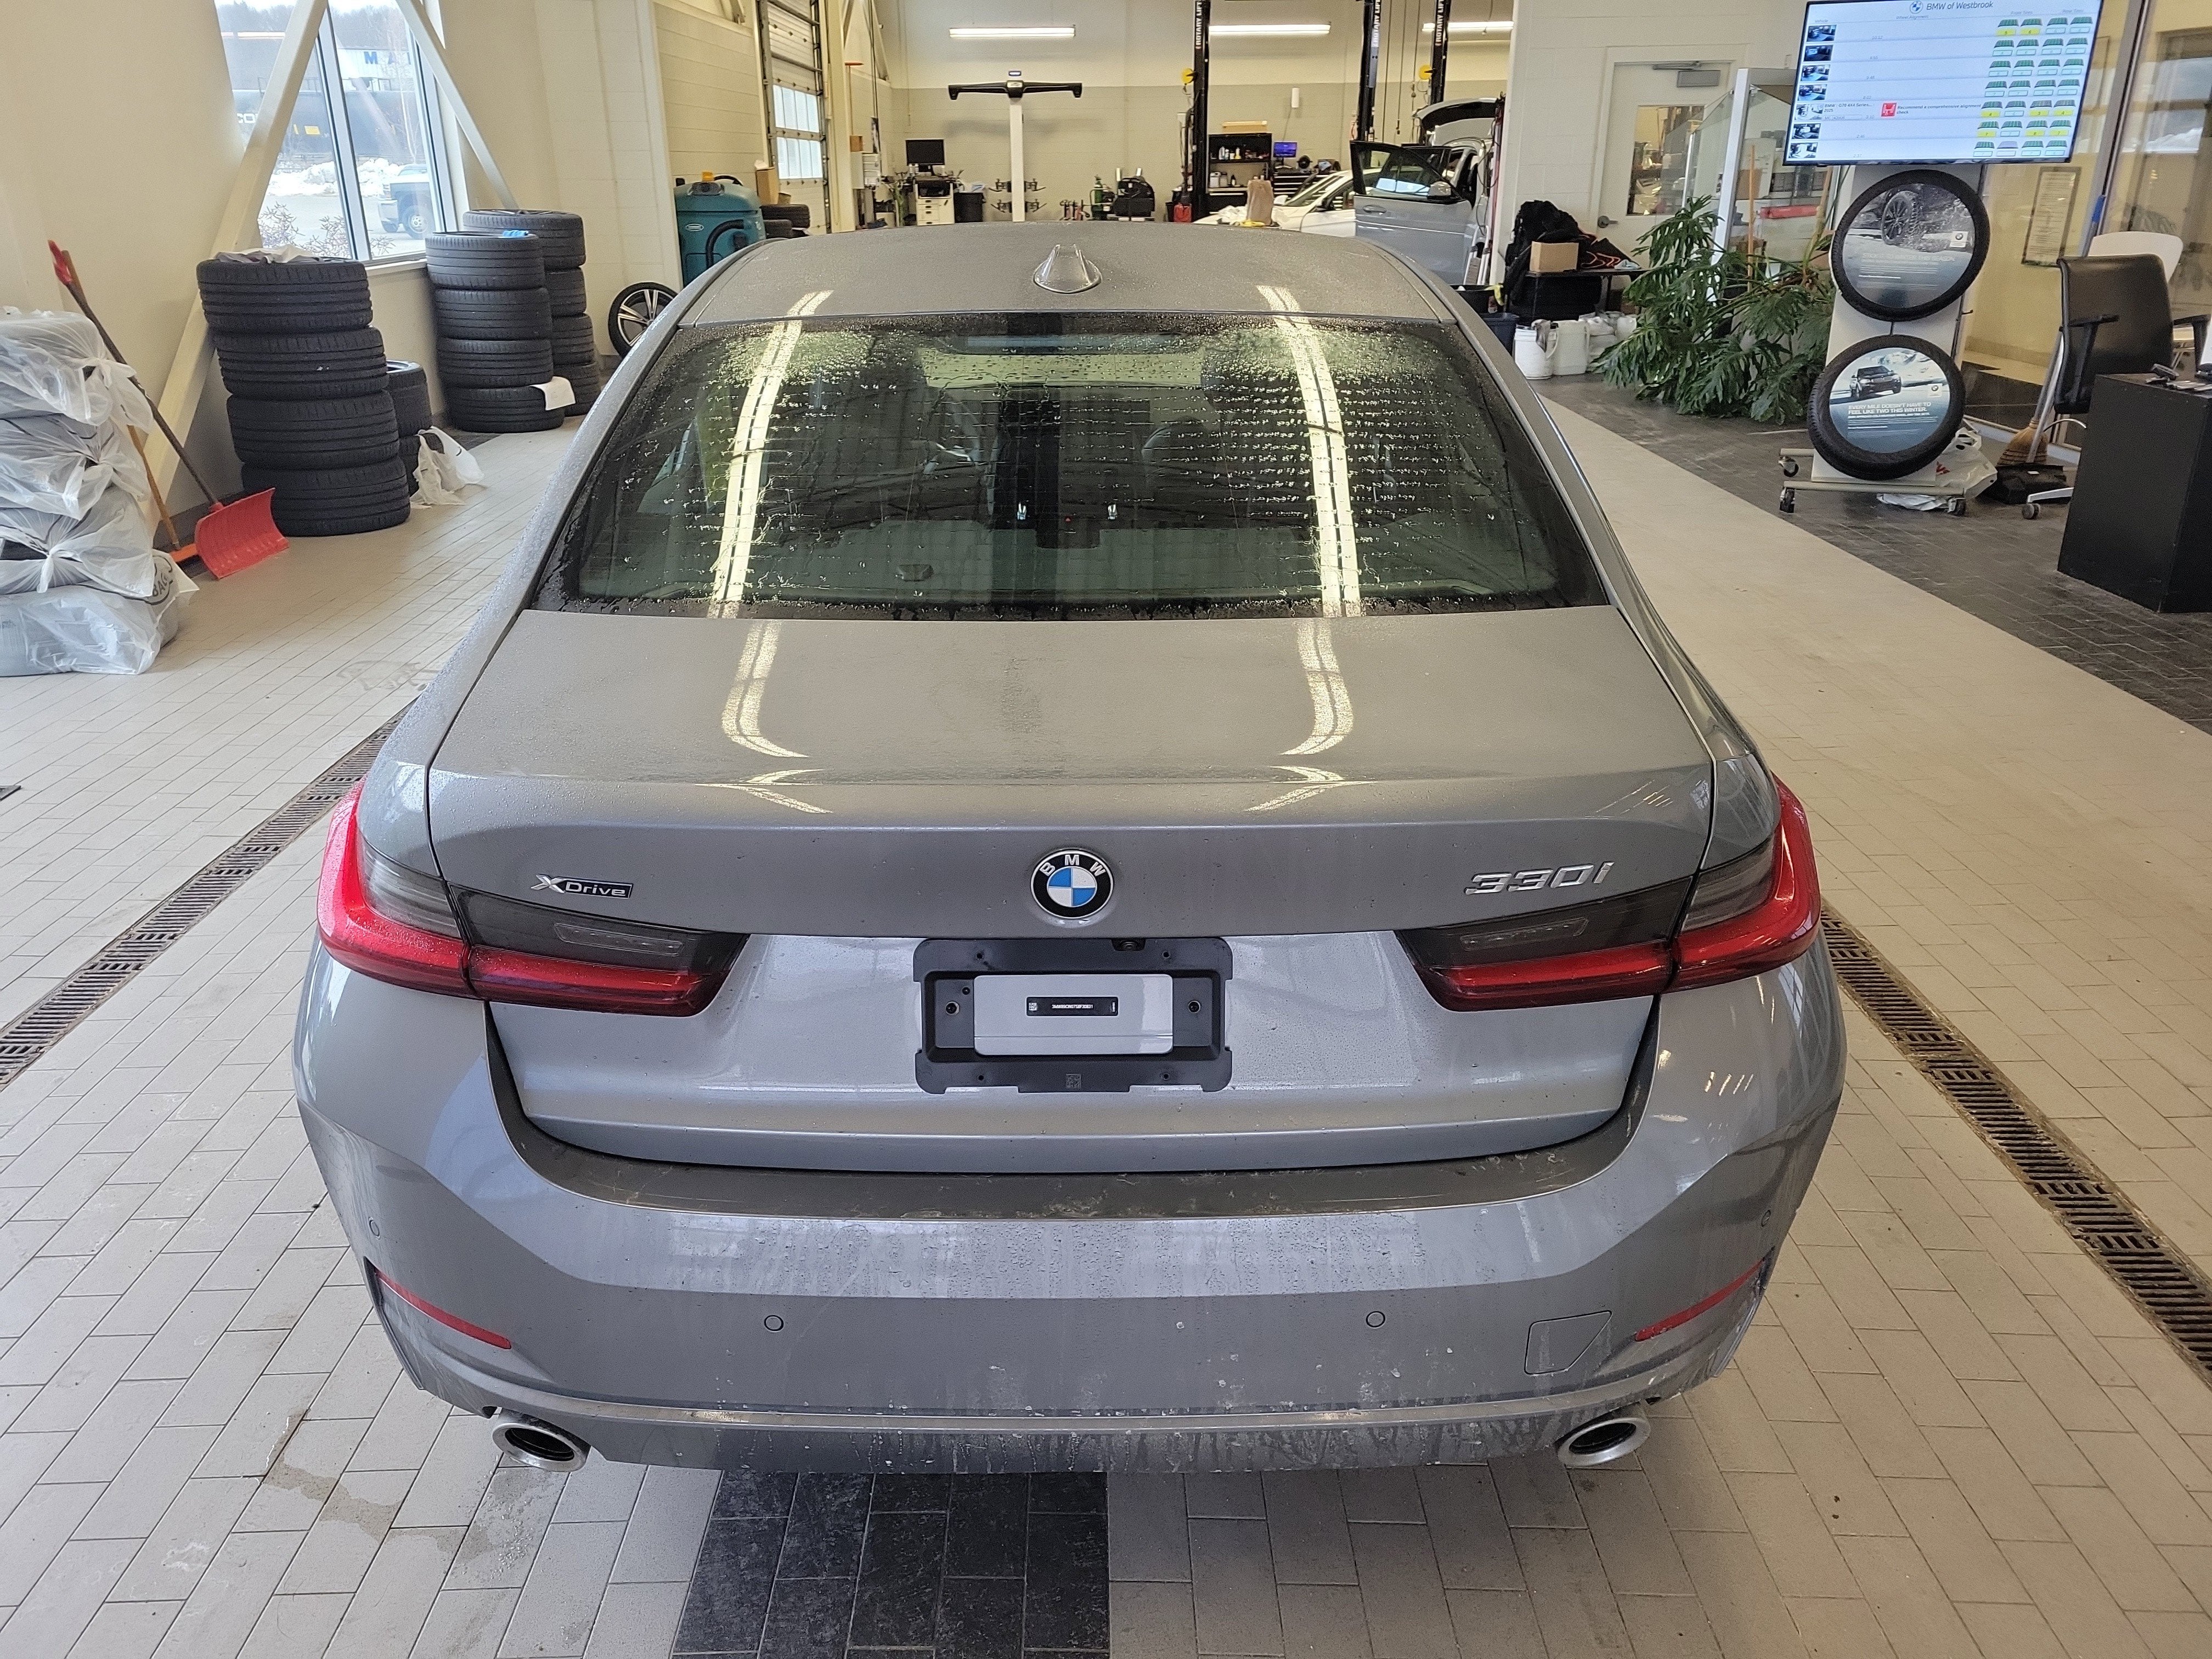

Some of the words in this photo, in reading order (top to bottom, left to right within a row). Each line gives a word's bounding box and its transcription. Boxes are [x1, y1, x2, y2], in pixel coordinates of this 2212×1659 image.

[1926, 2, 1946, 10] BMW
[1956, 1, 1994, 9] Westbrook
[1039, 854, 1106, 877] BMW
[1464, 861, 1615, 895] 330i
